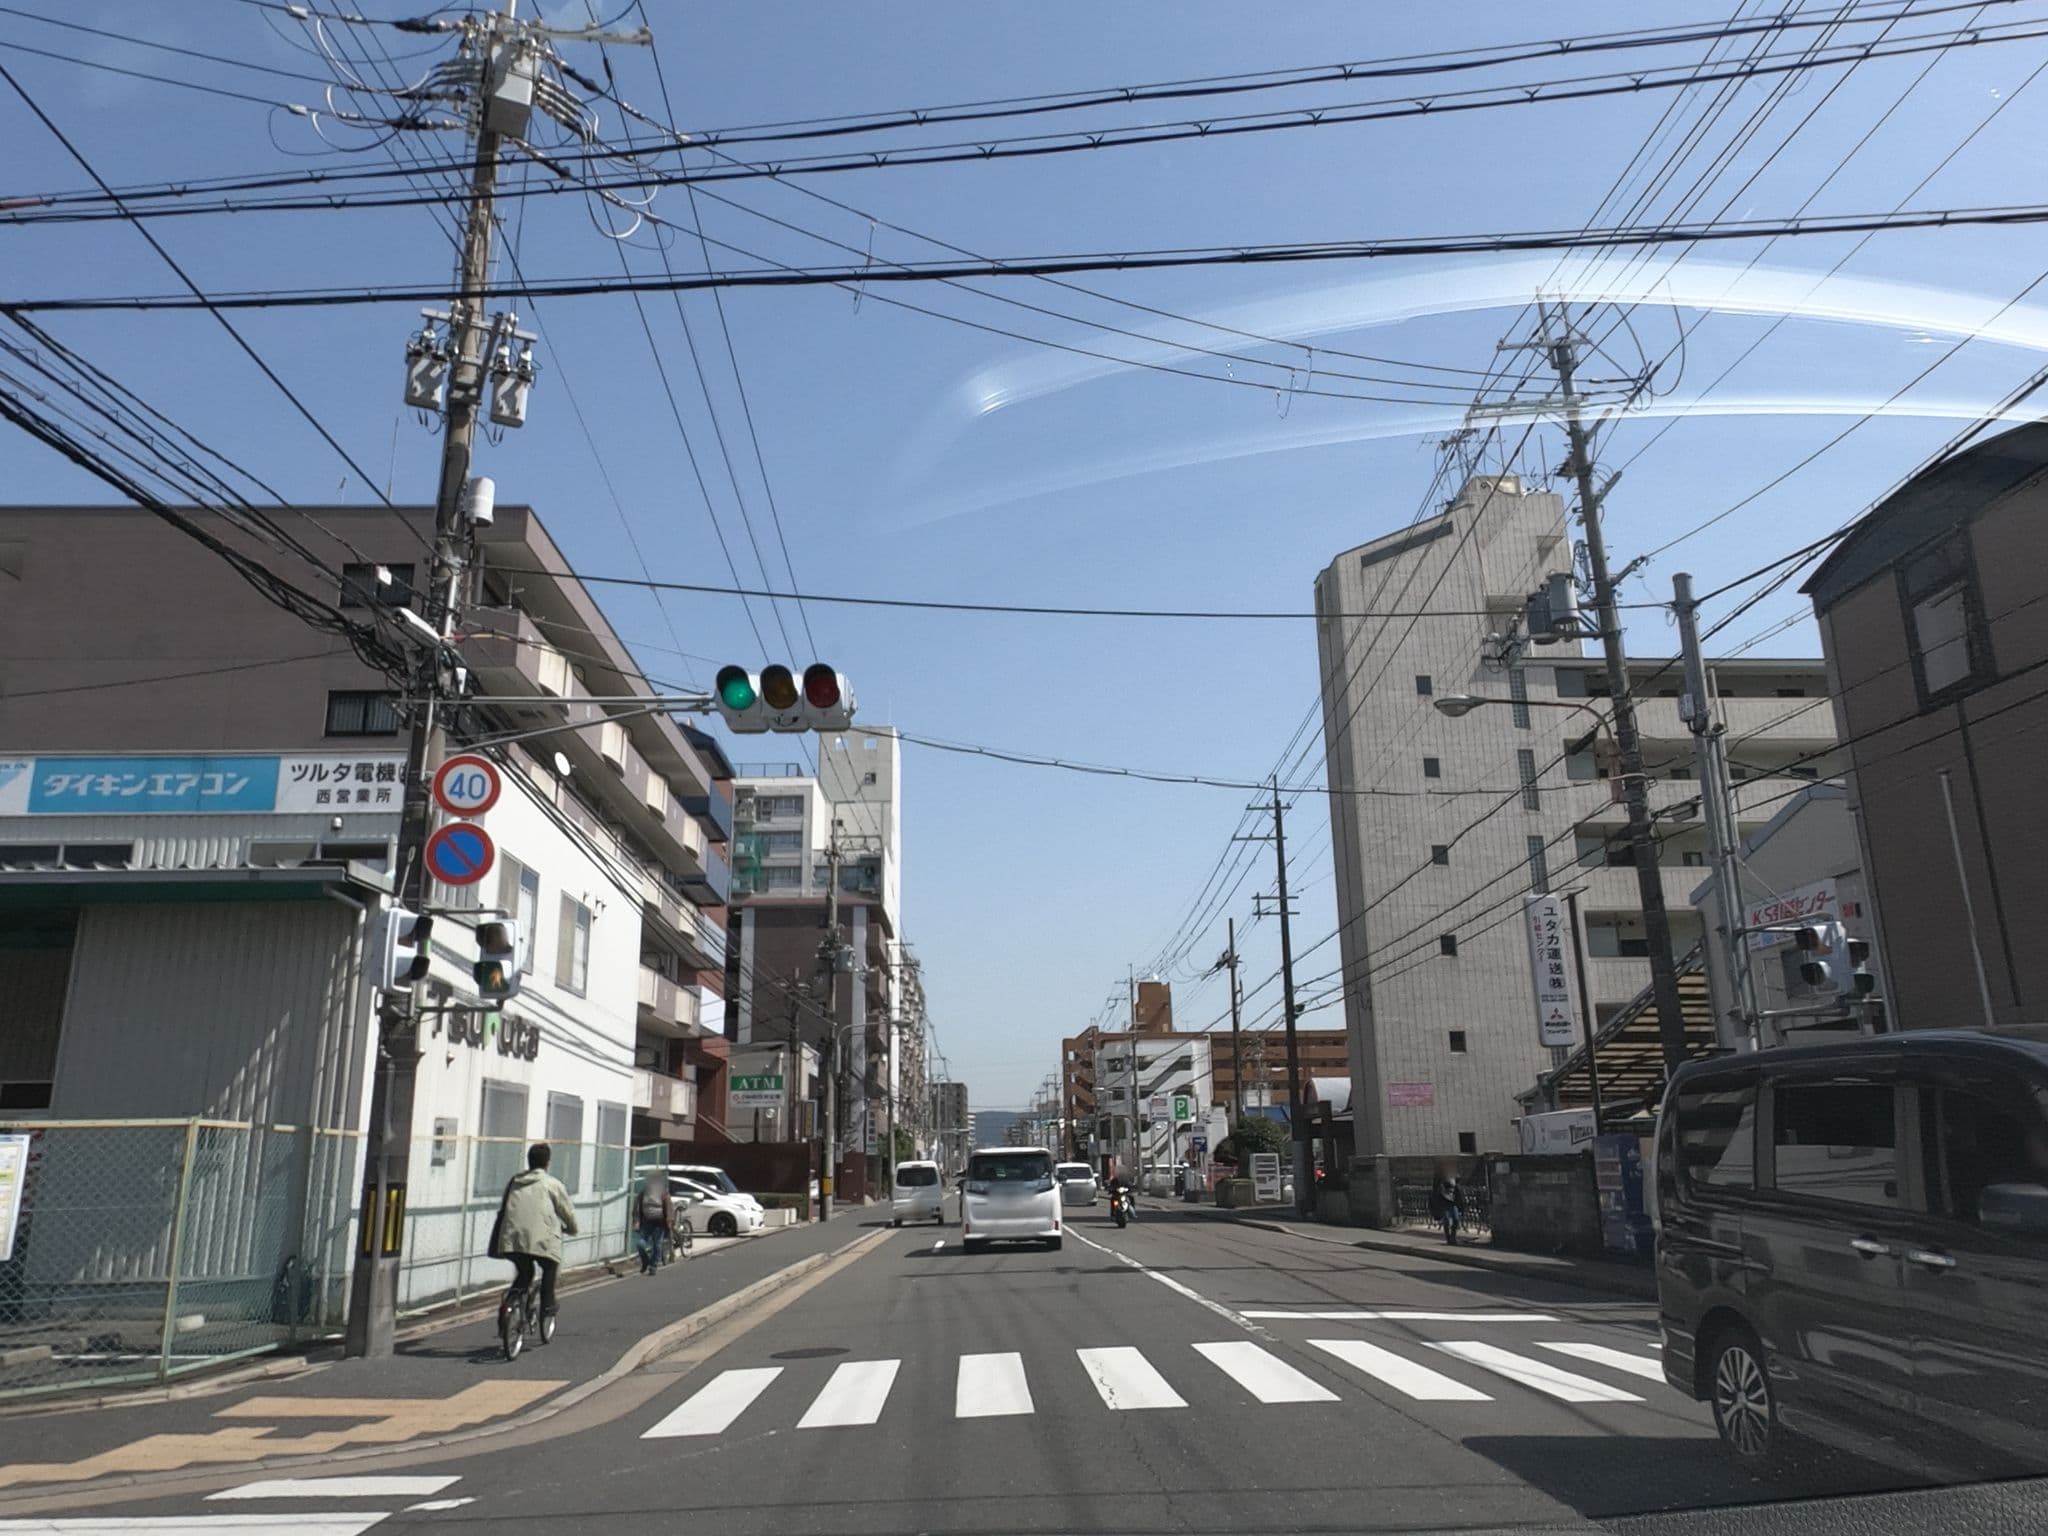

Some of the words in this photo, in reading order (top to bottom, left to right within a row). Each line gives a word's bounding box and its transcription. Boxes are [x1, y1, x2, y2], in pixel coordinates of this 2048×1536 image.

[43, 771, 250, 797] ダイキンエアコン
[449, 772, 487, 800] 40
[316, 787, 392, 804] 西営業所
[738, 1077, 777, 1089] ATM
[1177, 1100, 1186, 1112] P
